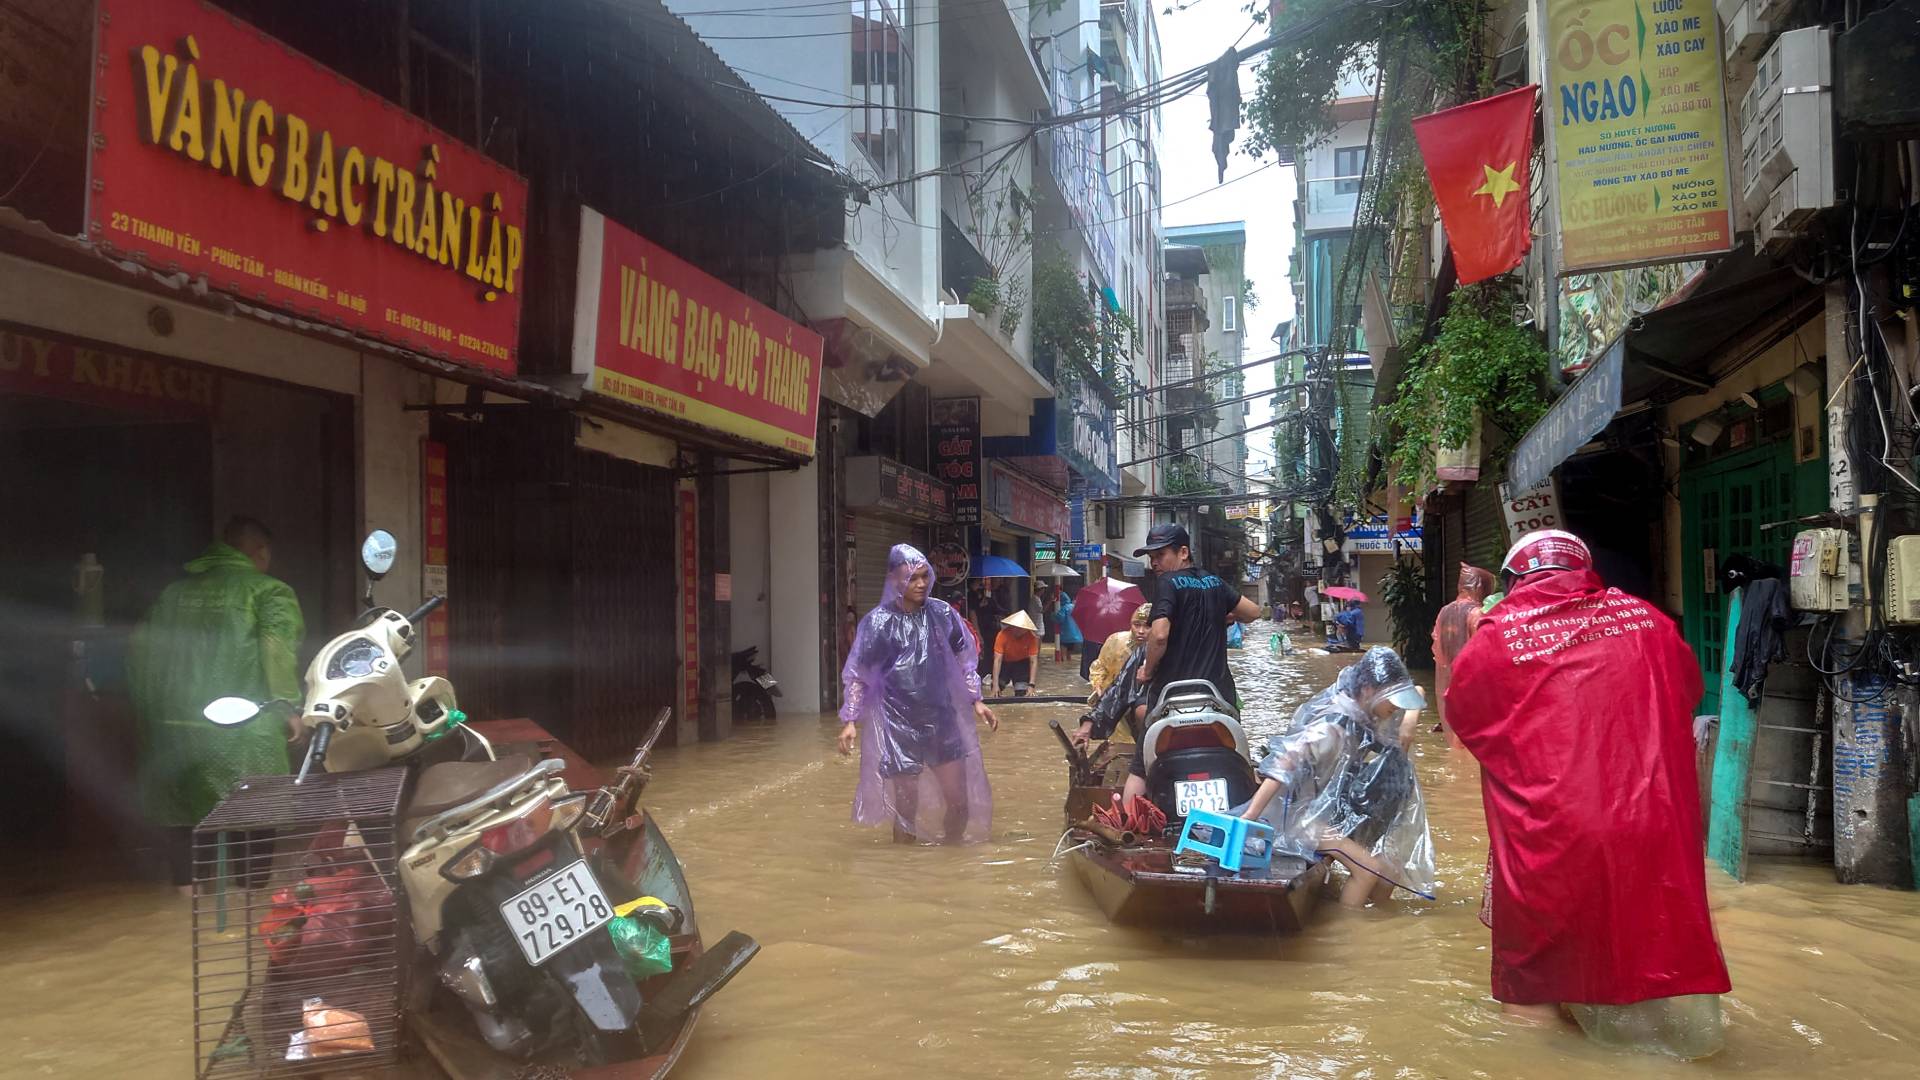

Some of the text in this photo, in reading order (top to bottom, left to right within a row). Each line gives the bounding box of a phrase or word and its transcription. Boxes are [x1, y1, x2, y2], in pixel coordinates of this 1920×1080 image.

[1558, 8, 1630, 72] ỐC
[1682, 16, 1701, 31] ME
[1684, 37, 1706, 53] CAY
[1560, 75, 1636, 126] NGAO
[142, 34, 522, 302] VÀNG BẠC TRẦN LẬP
[1675, 167, 1690, 176] ME
[1701, 200, 1719, 208] ME
[111, 211, 129, 232] 23
[131, 218, 175, 248] THANH
[176, 233, 200, 257] YÊN
[210, 246, 241, 271] PHÚC
[619, 256, 811, 416] VÀNG BẠC ĐỨC THẮNG
[1503, 628, 1518, 639] 25
[1540, 633, 1559, 644] TT.
[516, 871, 585, 926] 89-E1
[522, 893, 608, 959] 729.28
